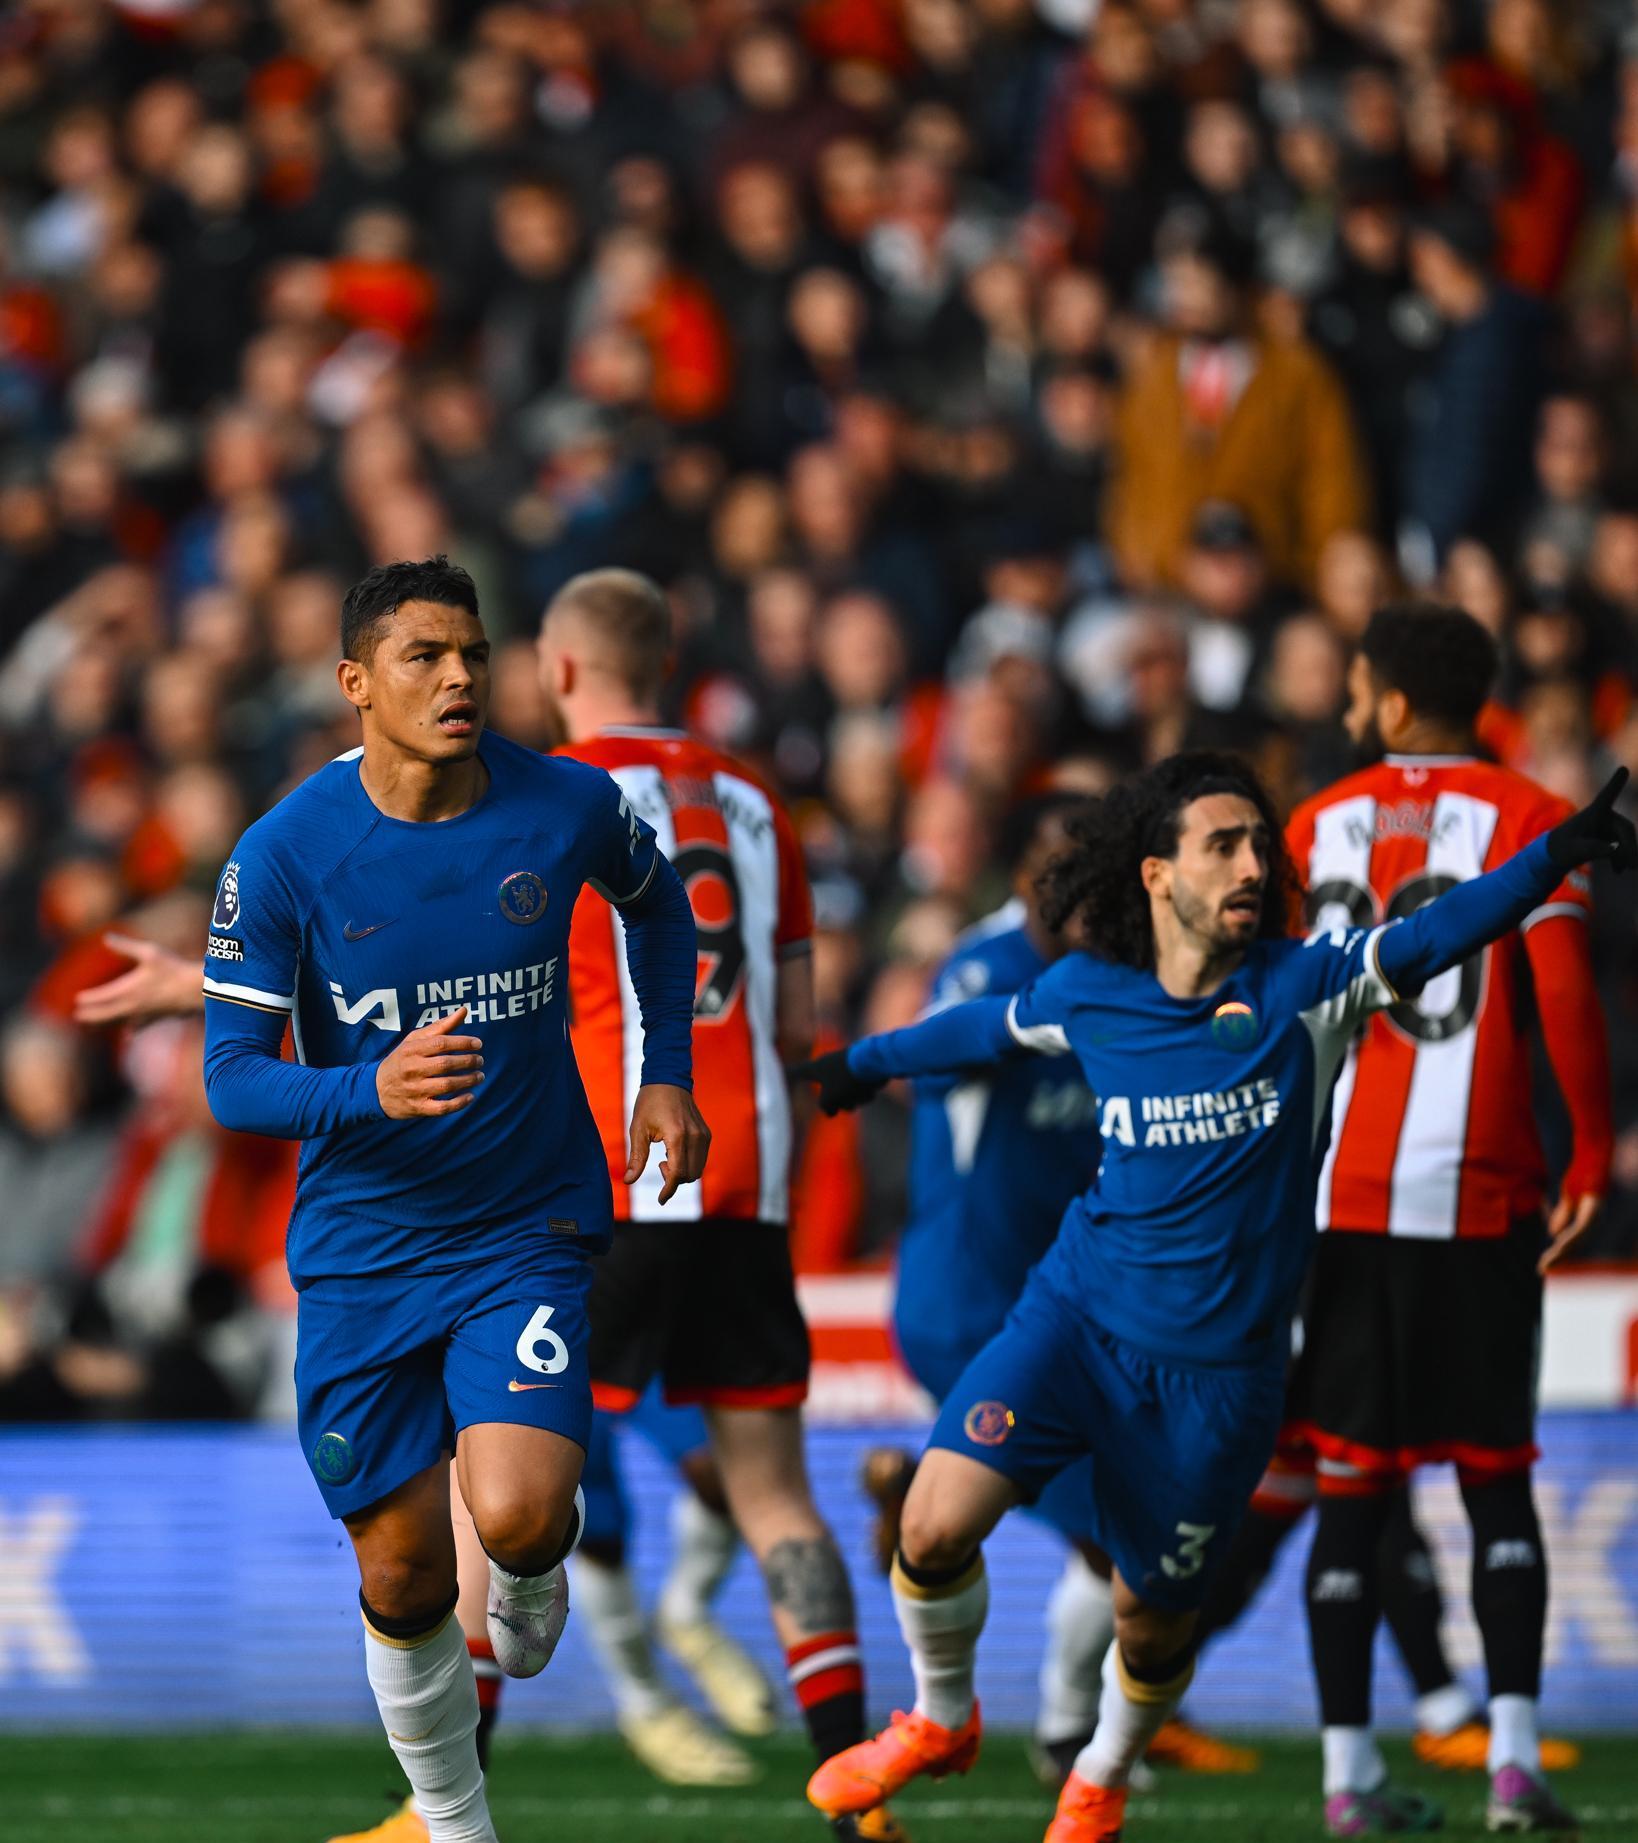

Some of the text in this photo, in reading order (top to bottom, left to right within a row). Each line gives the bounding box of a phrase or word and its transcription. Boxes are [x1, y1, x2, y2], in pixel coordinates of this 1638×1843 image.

[416, 956, 558, 1005] INFINITE
[1141, 1077, 1279, 1122] INFINITE
[1145, 1100, 1280, 1147] ATHLETE
[516, 1305, 569, 1374] 6
[1160, 1521, 1216, 1580] 3
